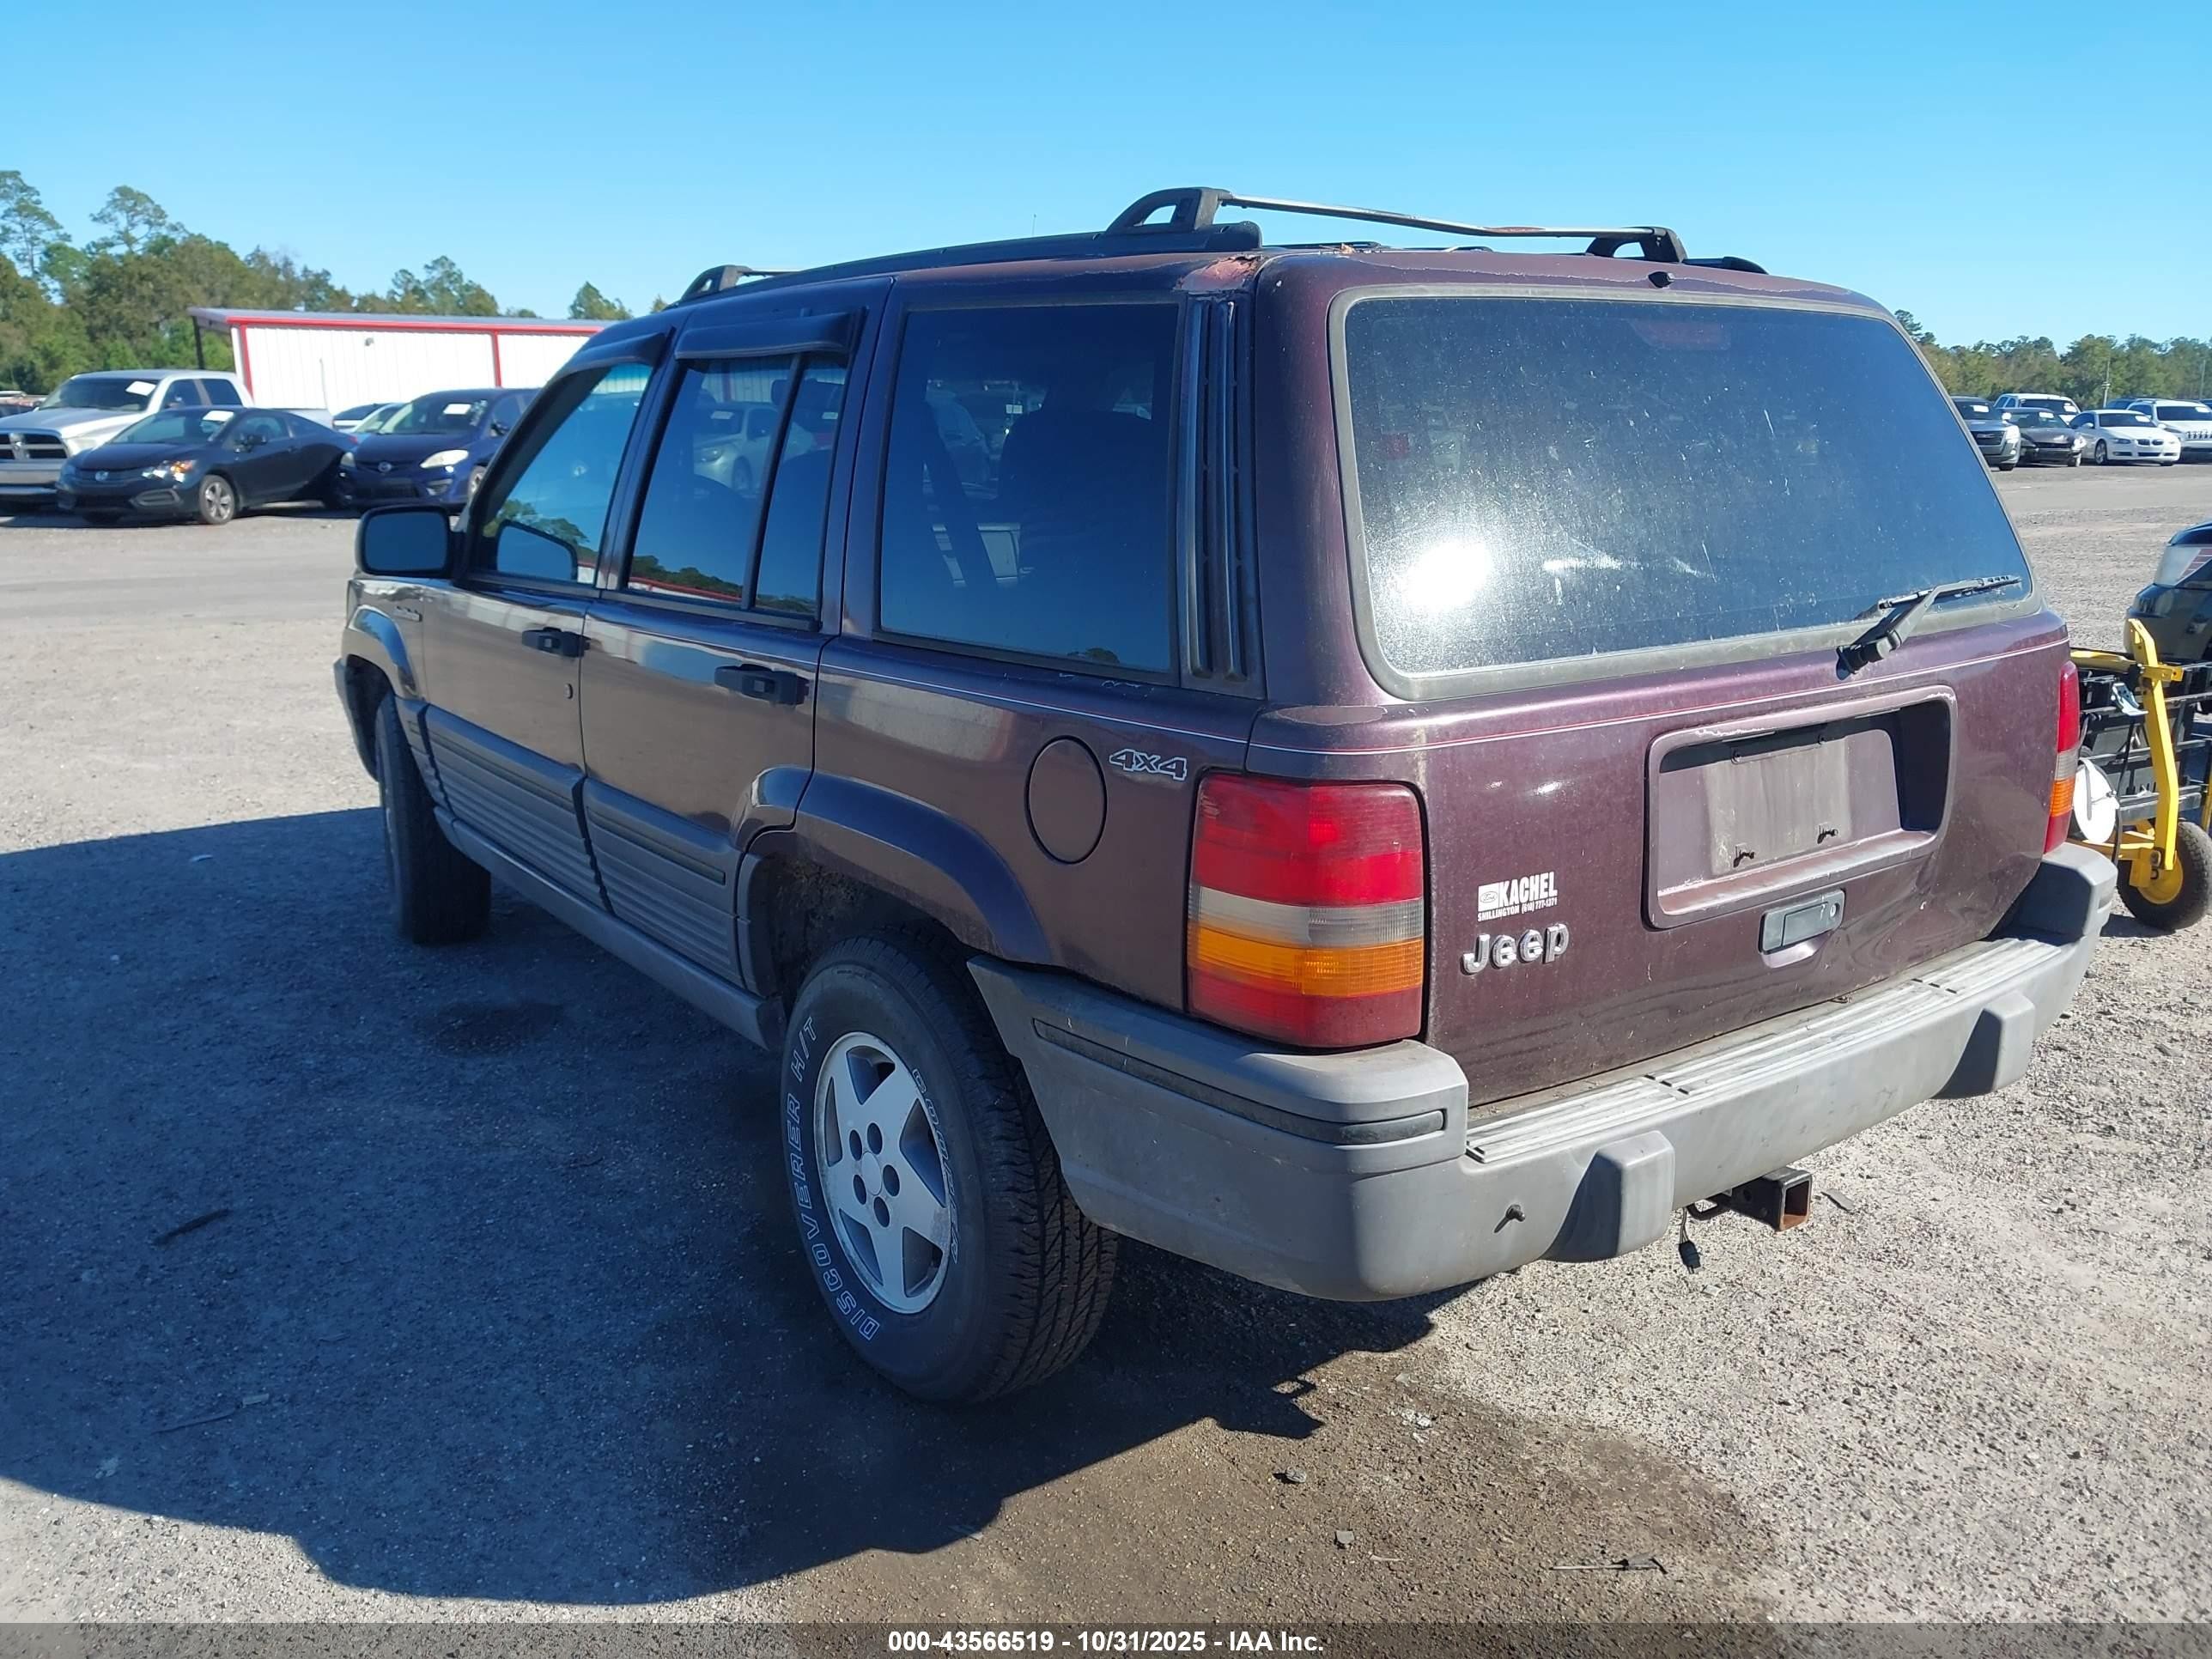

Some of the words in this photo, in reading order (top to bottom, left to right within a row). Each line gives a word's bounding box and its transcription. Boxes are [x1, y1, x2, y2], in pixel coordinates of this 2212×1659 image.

[1477, 904, 1520, 922] SHILLINGTON
[1499, 872, 1558, 908] KACHEL
[1462, 922, 1570, 975] Jeep
[789, 1016, 818, 1084] H/T
[787, 1091, 881, 1341] DISCOVERER
